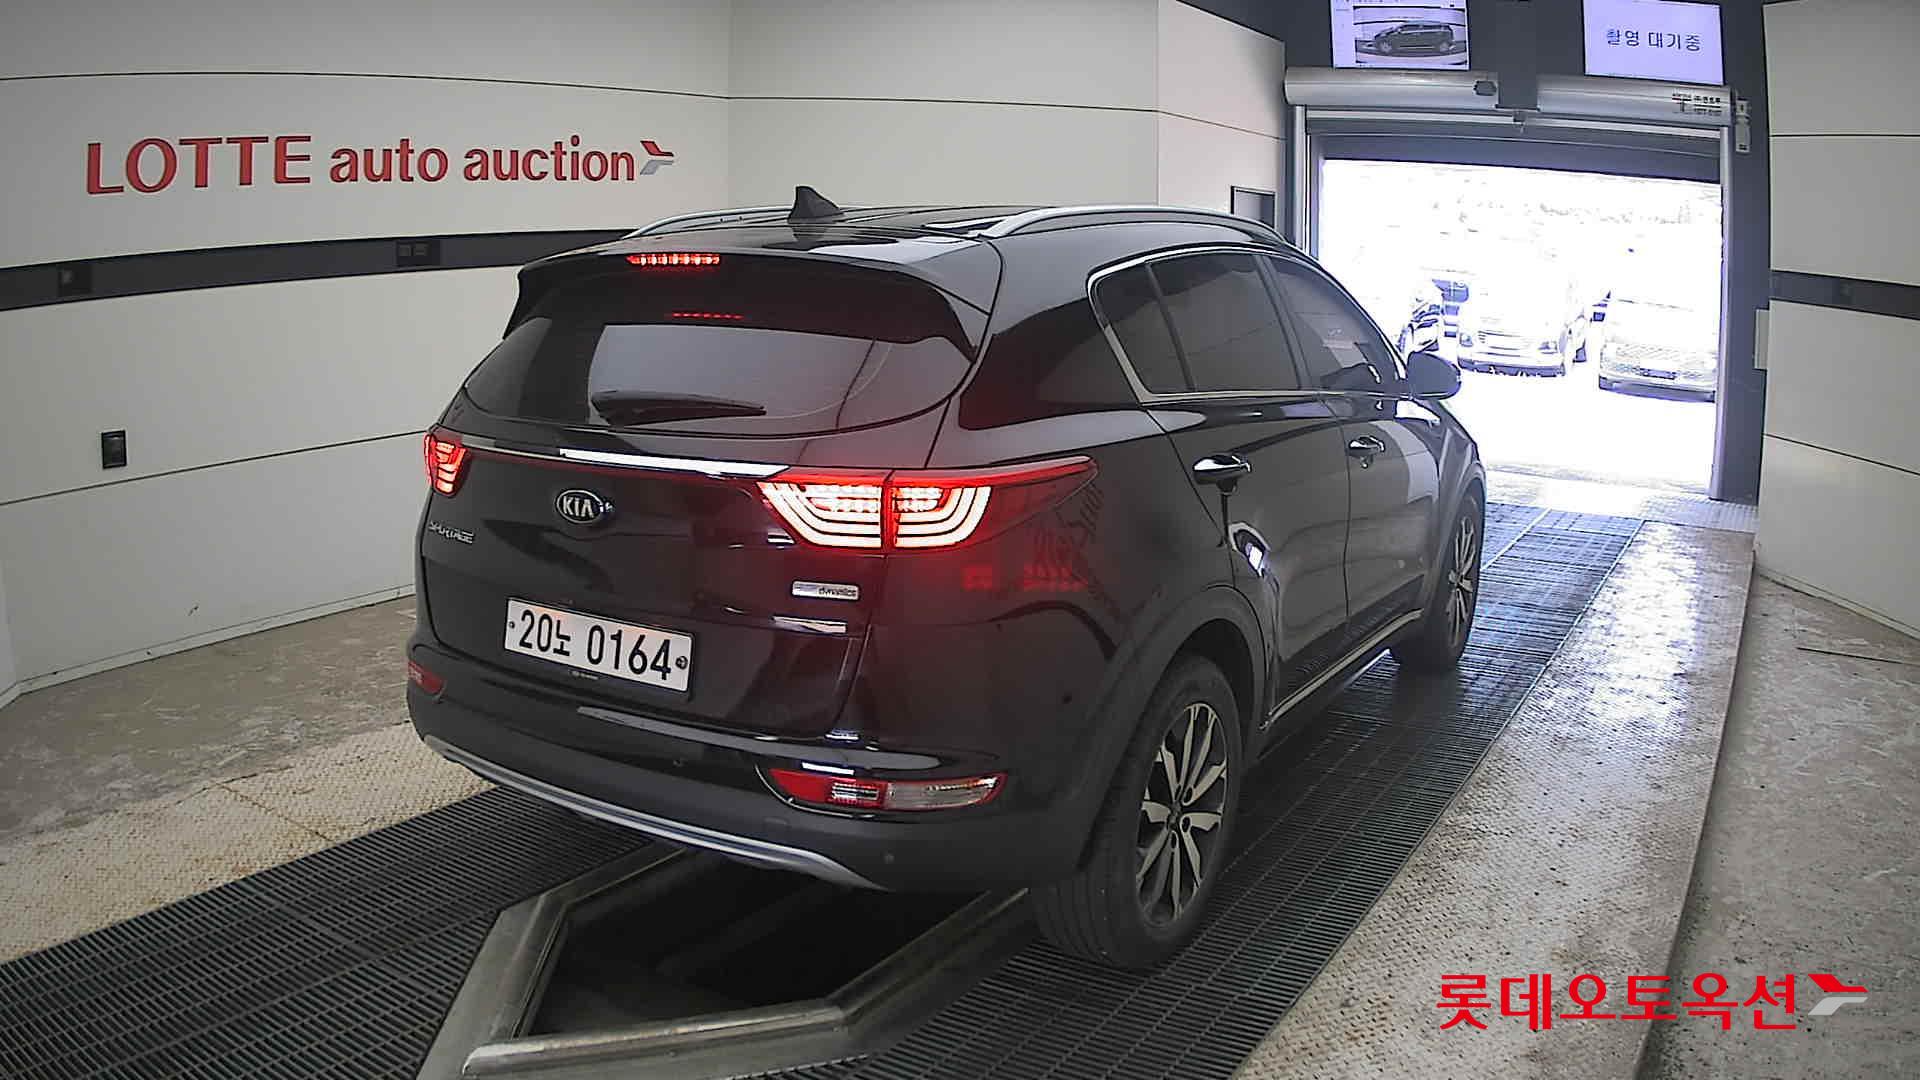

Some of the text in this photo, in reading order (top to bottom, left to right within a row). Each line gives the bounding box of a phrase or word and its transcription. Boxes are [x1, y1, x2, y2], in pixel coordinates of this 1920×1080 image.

[1648, 31, 1700, 52] 대기중
[87, 135, 635, 194] LOTTE auto auction
[563, 495, 595, 518] KIA
[519, 609, 672, 681] 20노 0164
